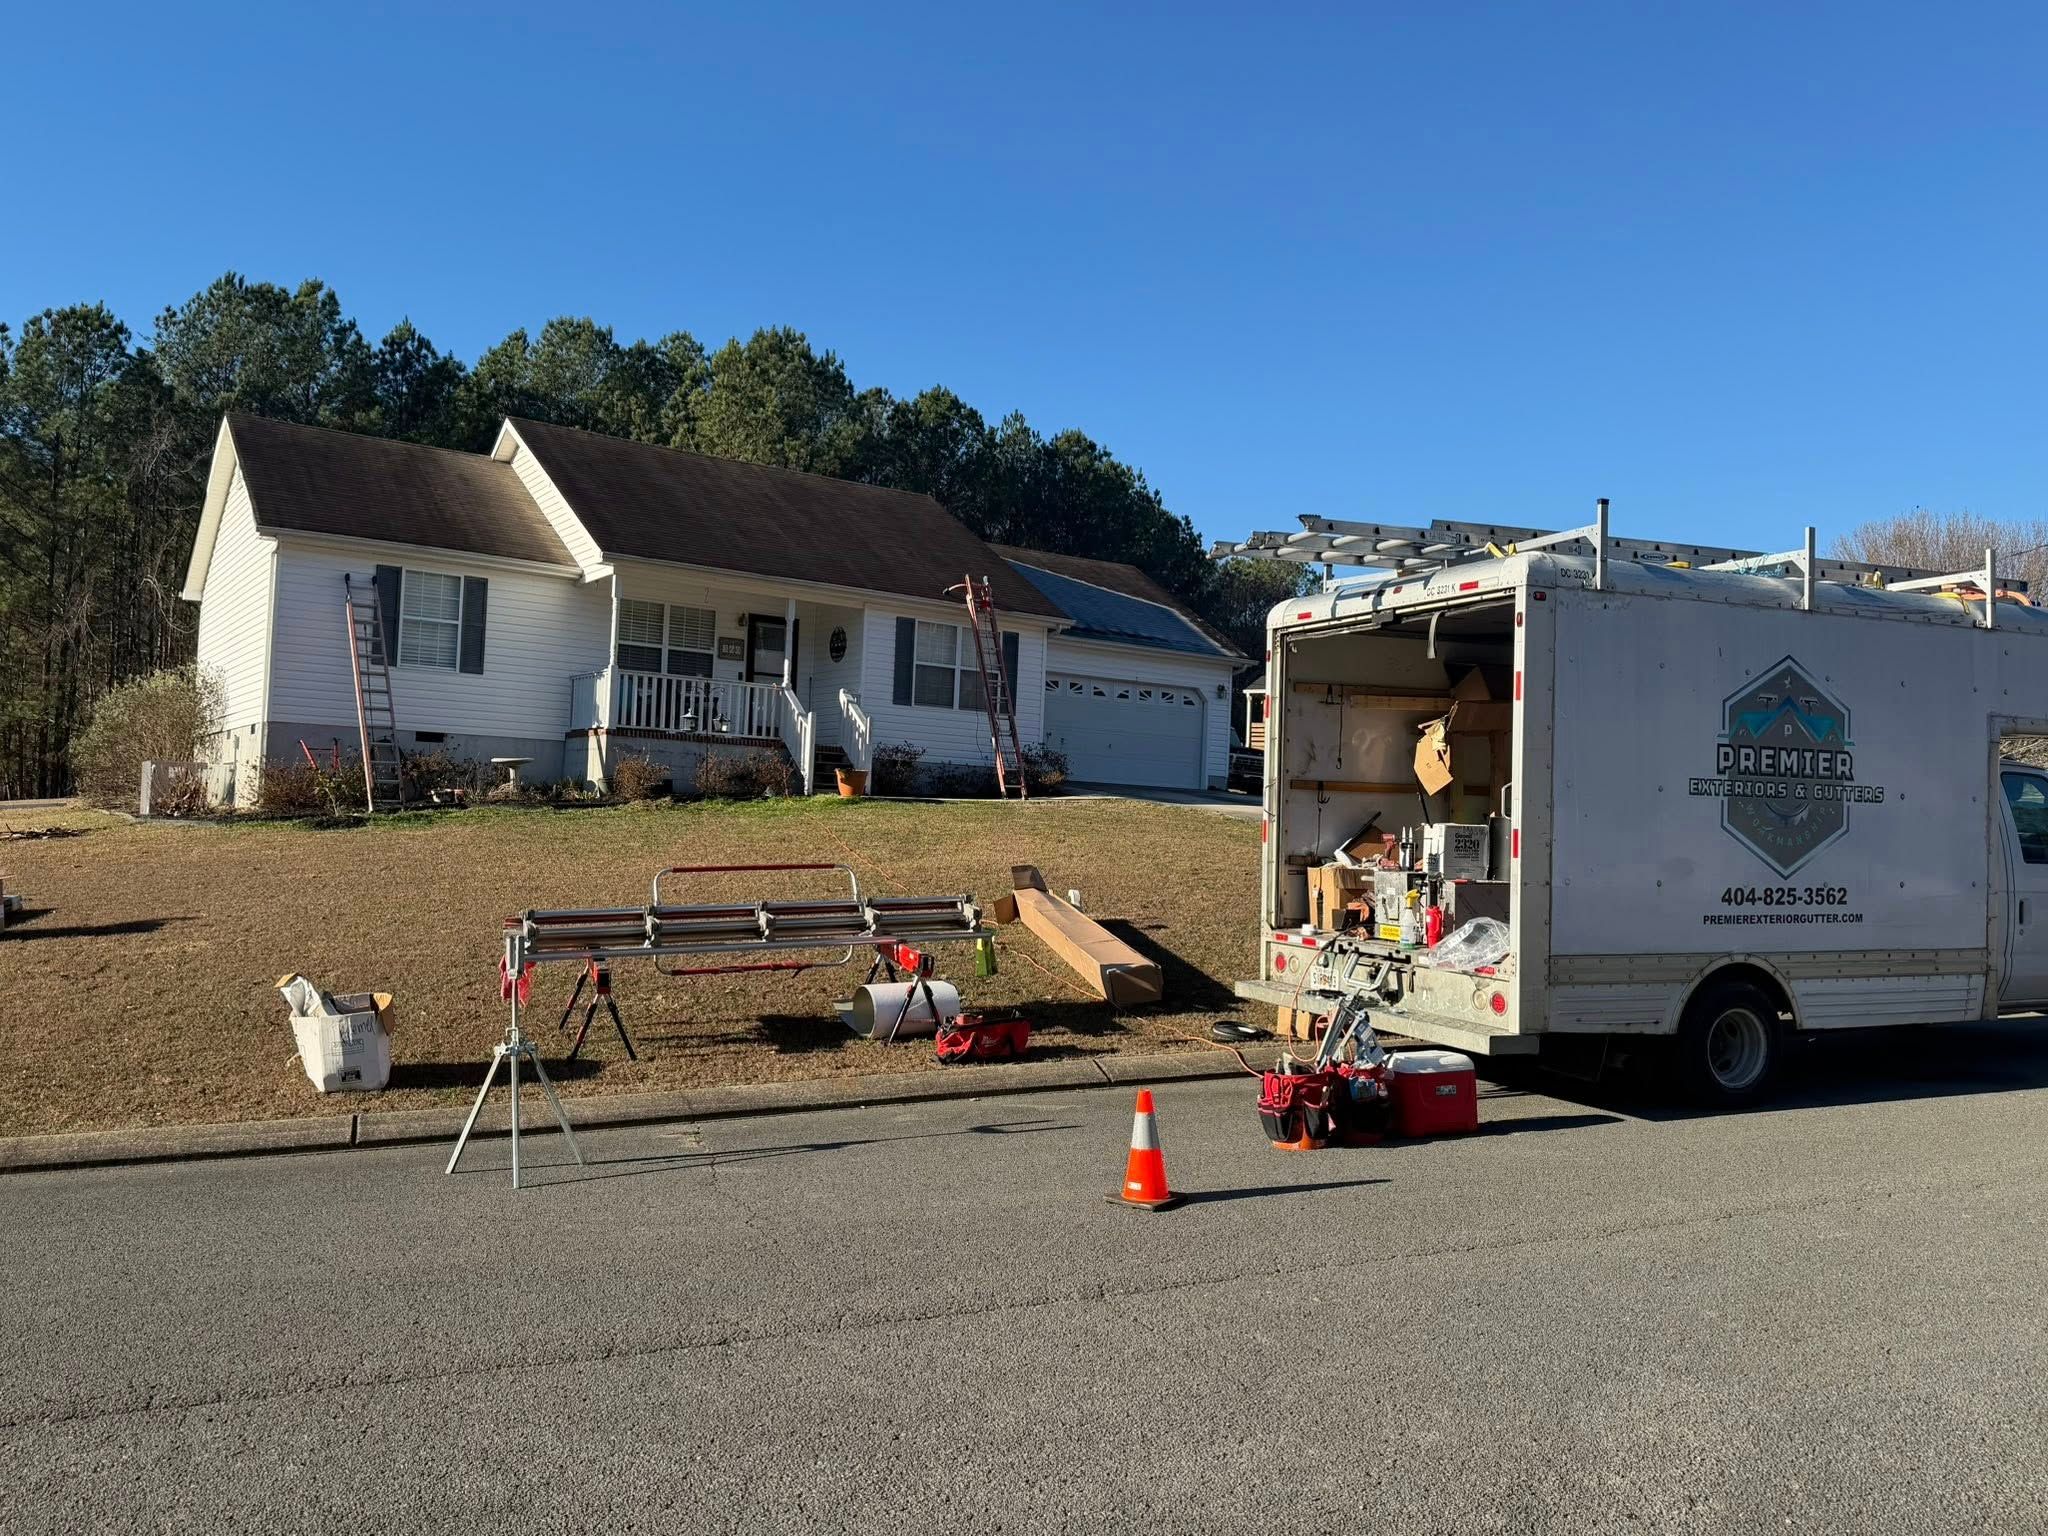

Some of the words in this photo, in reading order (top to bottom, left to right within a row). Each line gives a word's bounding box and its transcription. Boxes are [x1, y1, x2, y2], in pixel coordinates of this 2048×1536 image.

[1560, 568, 1571, 578] DC
[1574, 569, 1590, 580] 3231
[1717, 744, 1854, 781] PREMIER
[1689, 778, 1787, 798] EXTERIORS
[1795, 783, 1808, 800] &
[1814, 783, 1884, 803] GUTTERS
[1455, 838, 1480, 850] 2320
[1721, 887, 1848, 906] 404-825-3562
[1703, 913, 1864, 925] PREMIEREXTERIORGUTTER.COM
